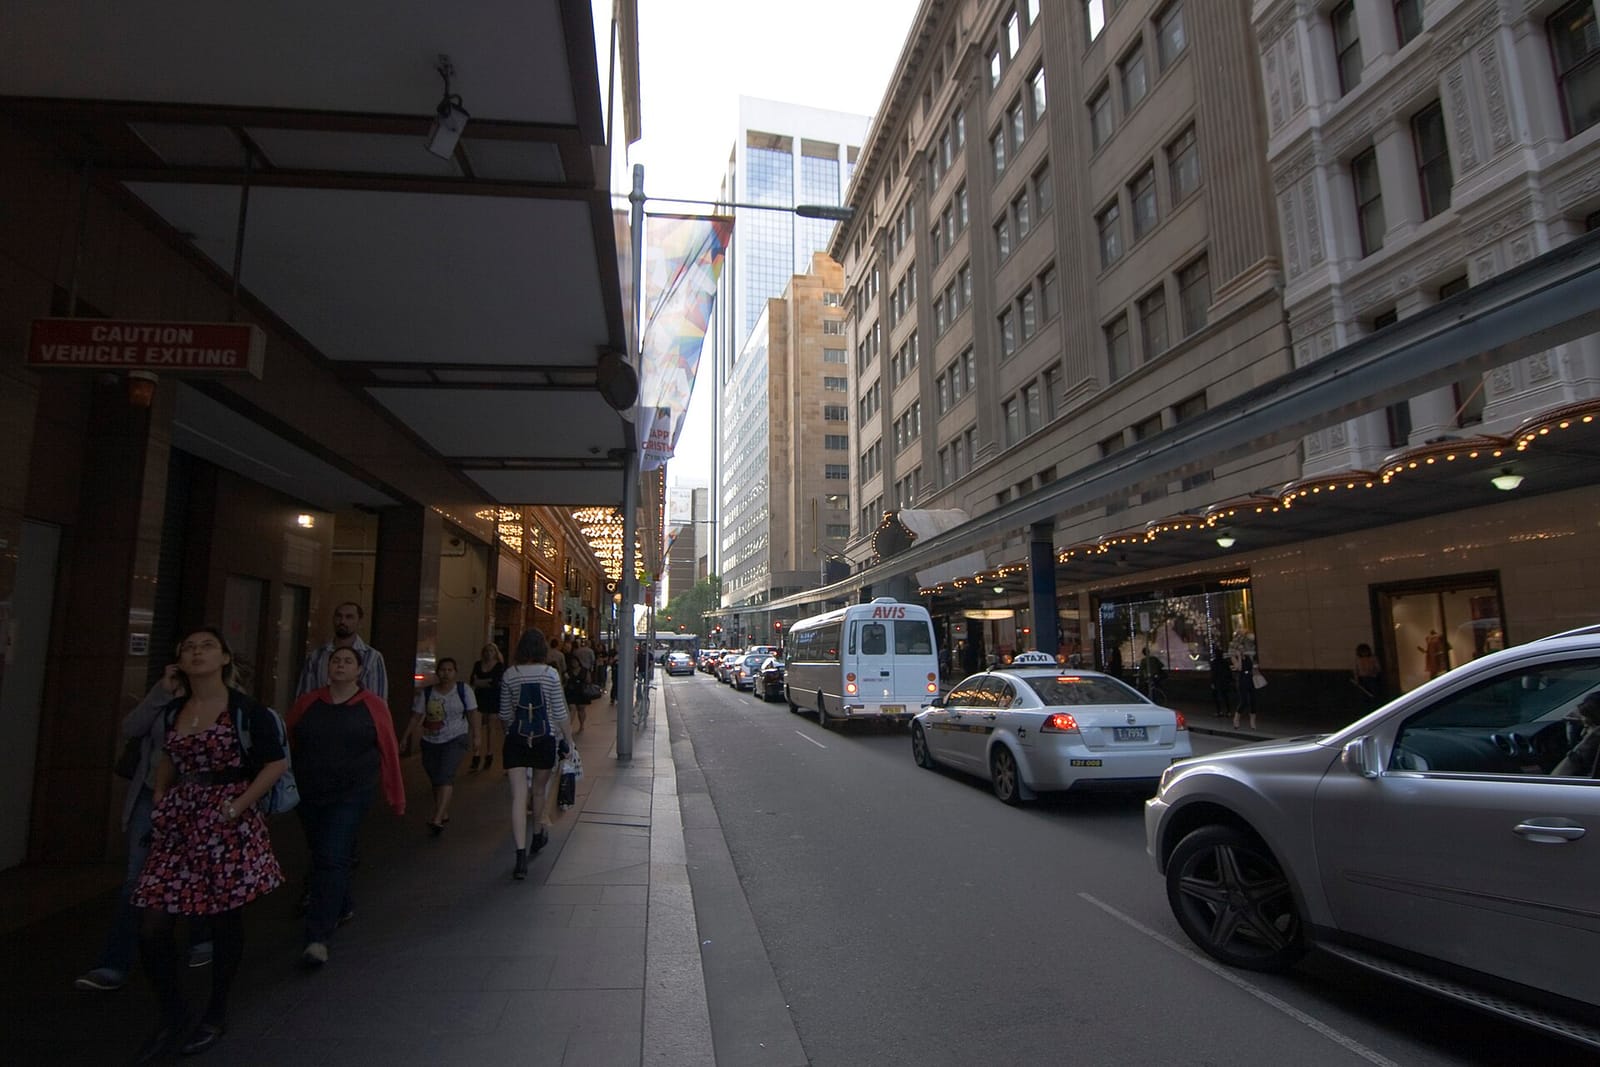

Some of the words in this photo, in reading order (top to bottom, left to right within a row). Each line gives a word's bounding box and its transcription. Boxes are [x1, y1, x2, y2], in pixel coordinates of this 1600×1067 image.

[91, 326, 194, 344] CAUTION
[40, 344, 138, 362] VEHICLE
[144, 346, 238, 365] EXITING
[872, 606, 907, 619] AVIS
[1024, 654, 1048, 662] TAXI
